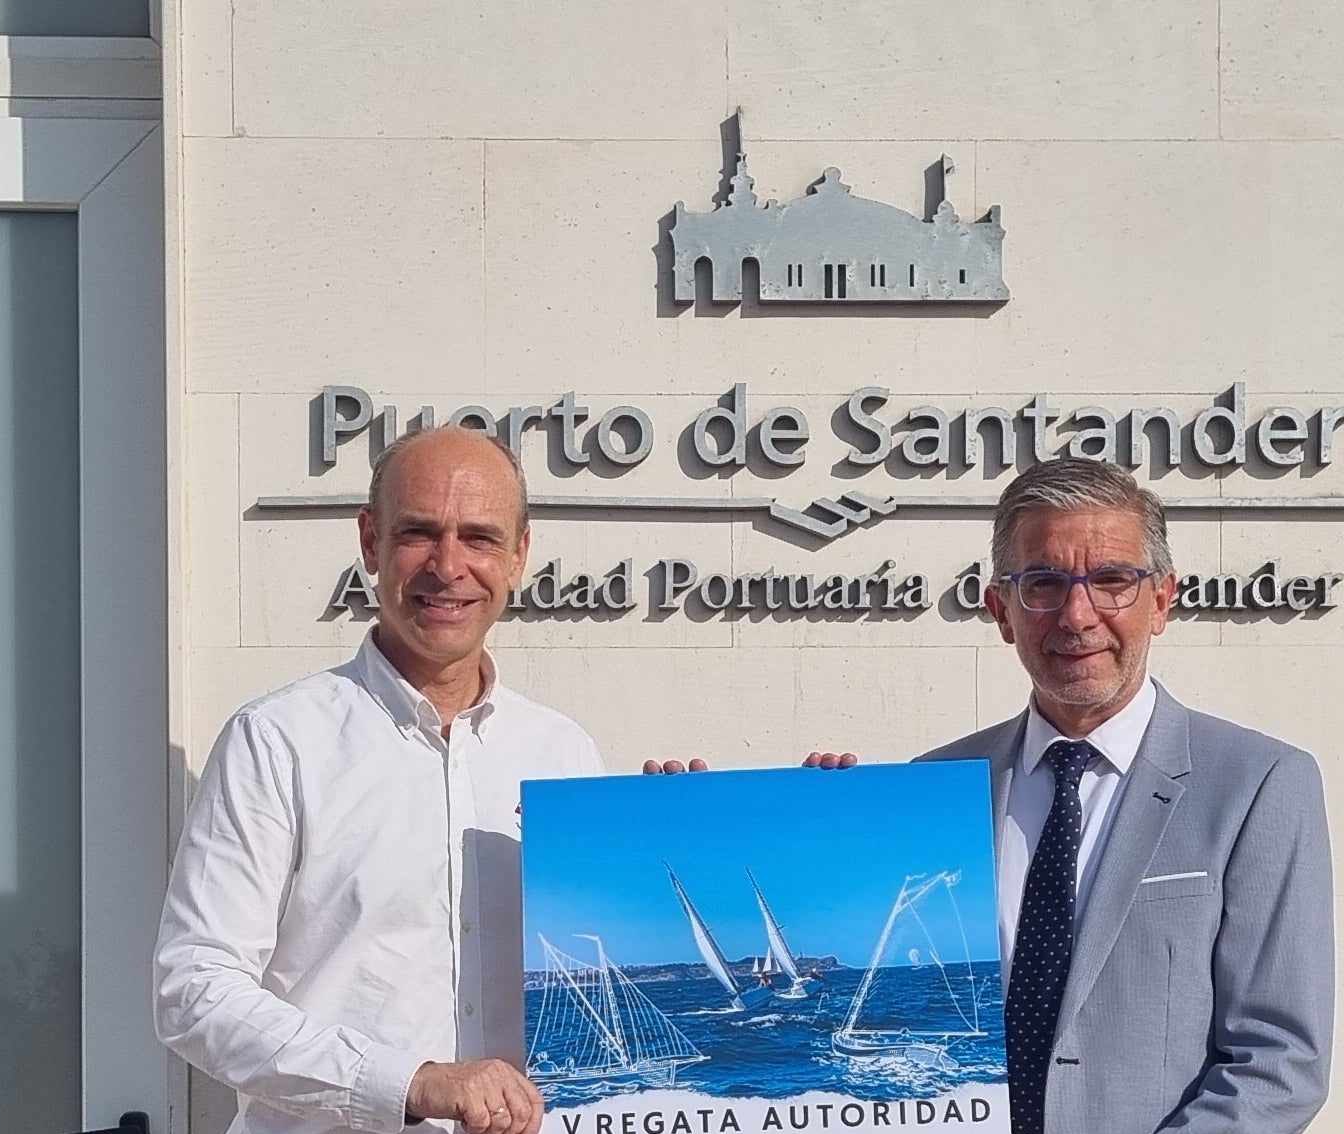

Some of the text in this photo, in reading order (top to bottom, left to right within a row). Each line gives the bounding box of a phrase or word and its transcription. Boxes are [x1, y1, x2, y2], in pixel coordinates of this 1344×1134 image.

[693, 382, 810, 466] de
[658, 557, 934, 610] Portuaria
[956, 557, 987, 610] d
[1170, 556, 1344, 611] ander
[761, 1097, 992, 1131] AUTORIDAD
